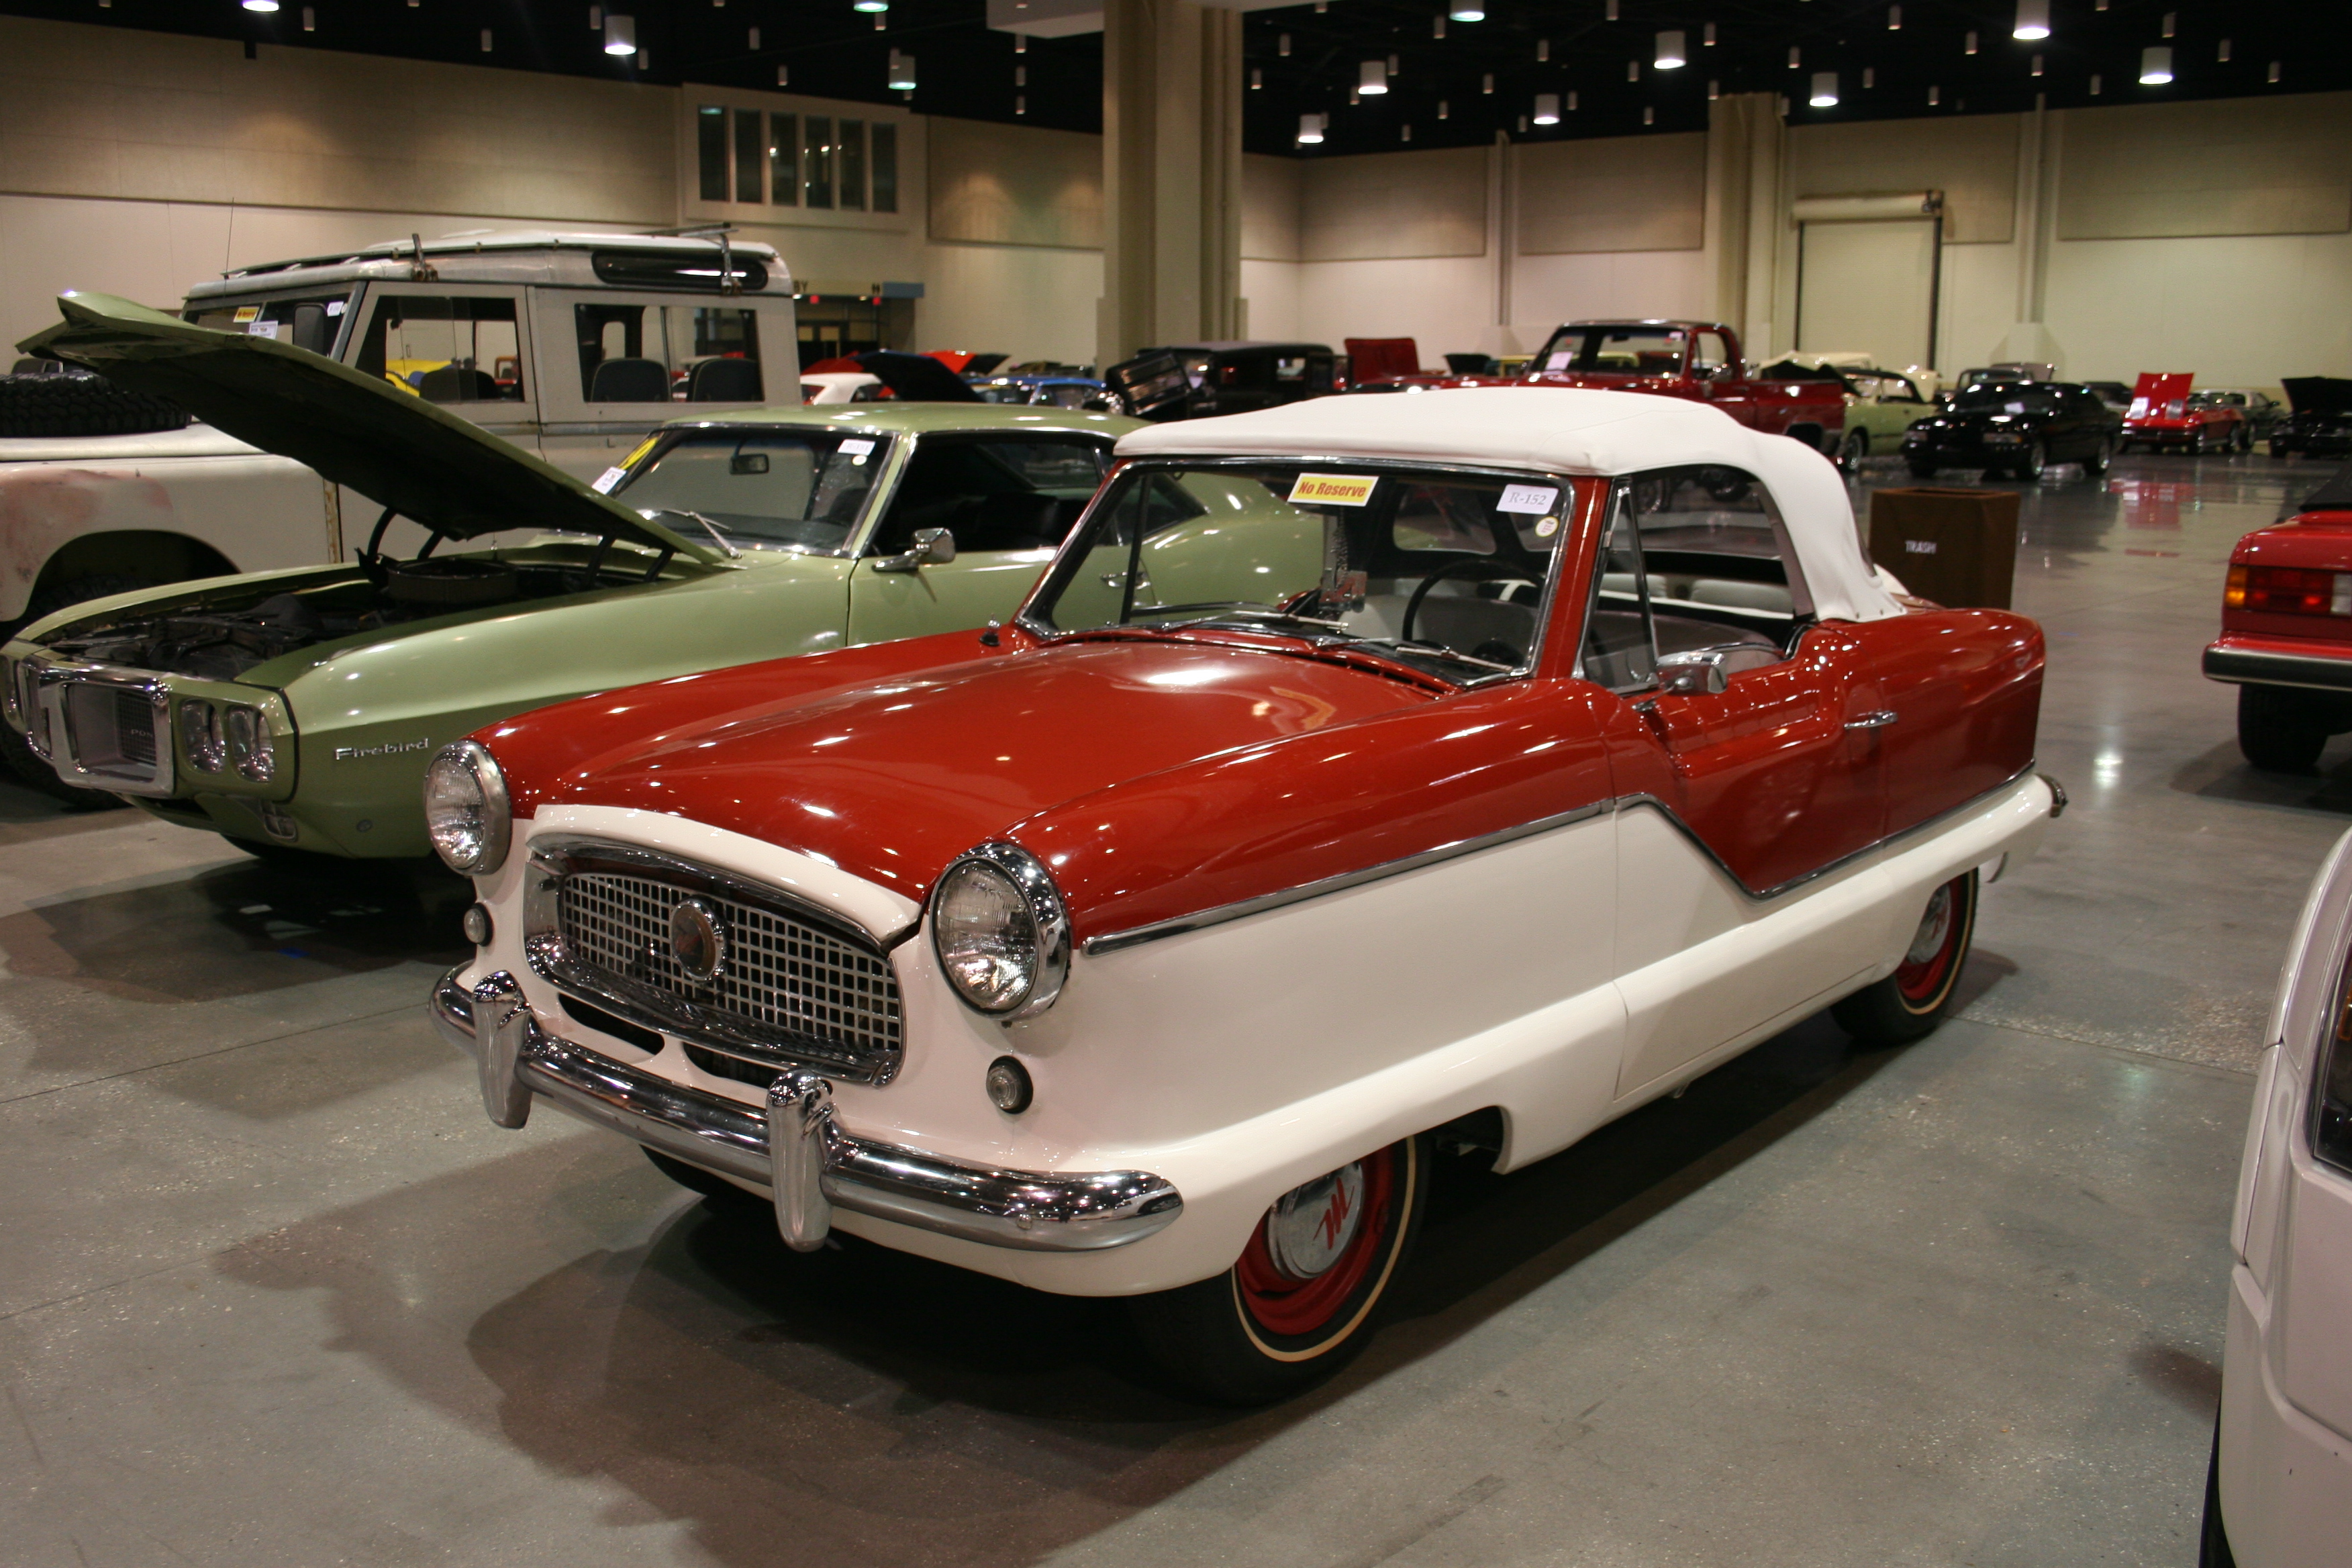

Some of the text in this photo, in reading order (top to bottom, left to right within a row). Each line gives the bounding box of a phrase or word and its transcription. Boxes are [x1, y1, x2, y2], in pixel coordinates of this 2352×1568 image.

[1297, 481, 1367, 497] No Reserve
[1508, 491, 1547, 505] R-152
[335, 738, 429, 761] Firebird
